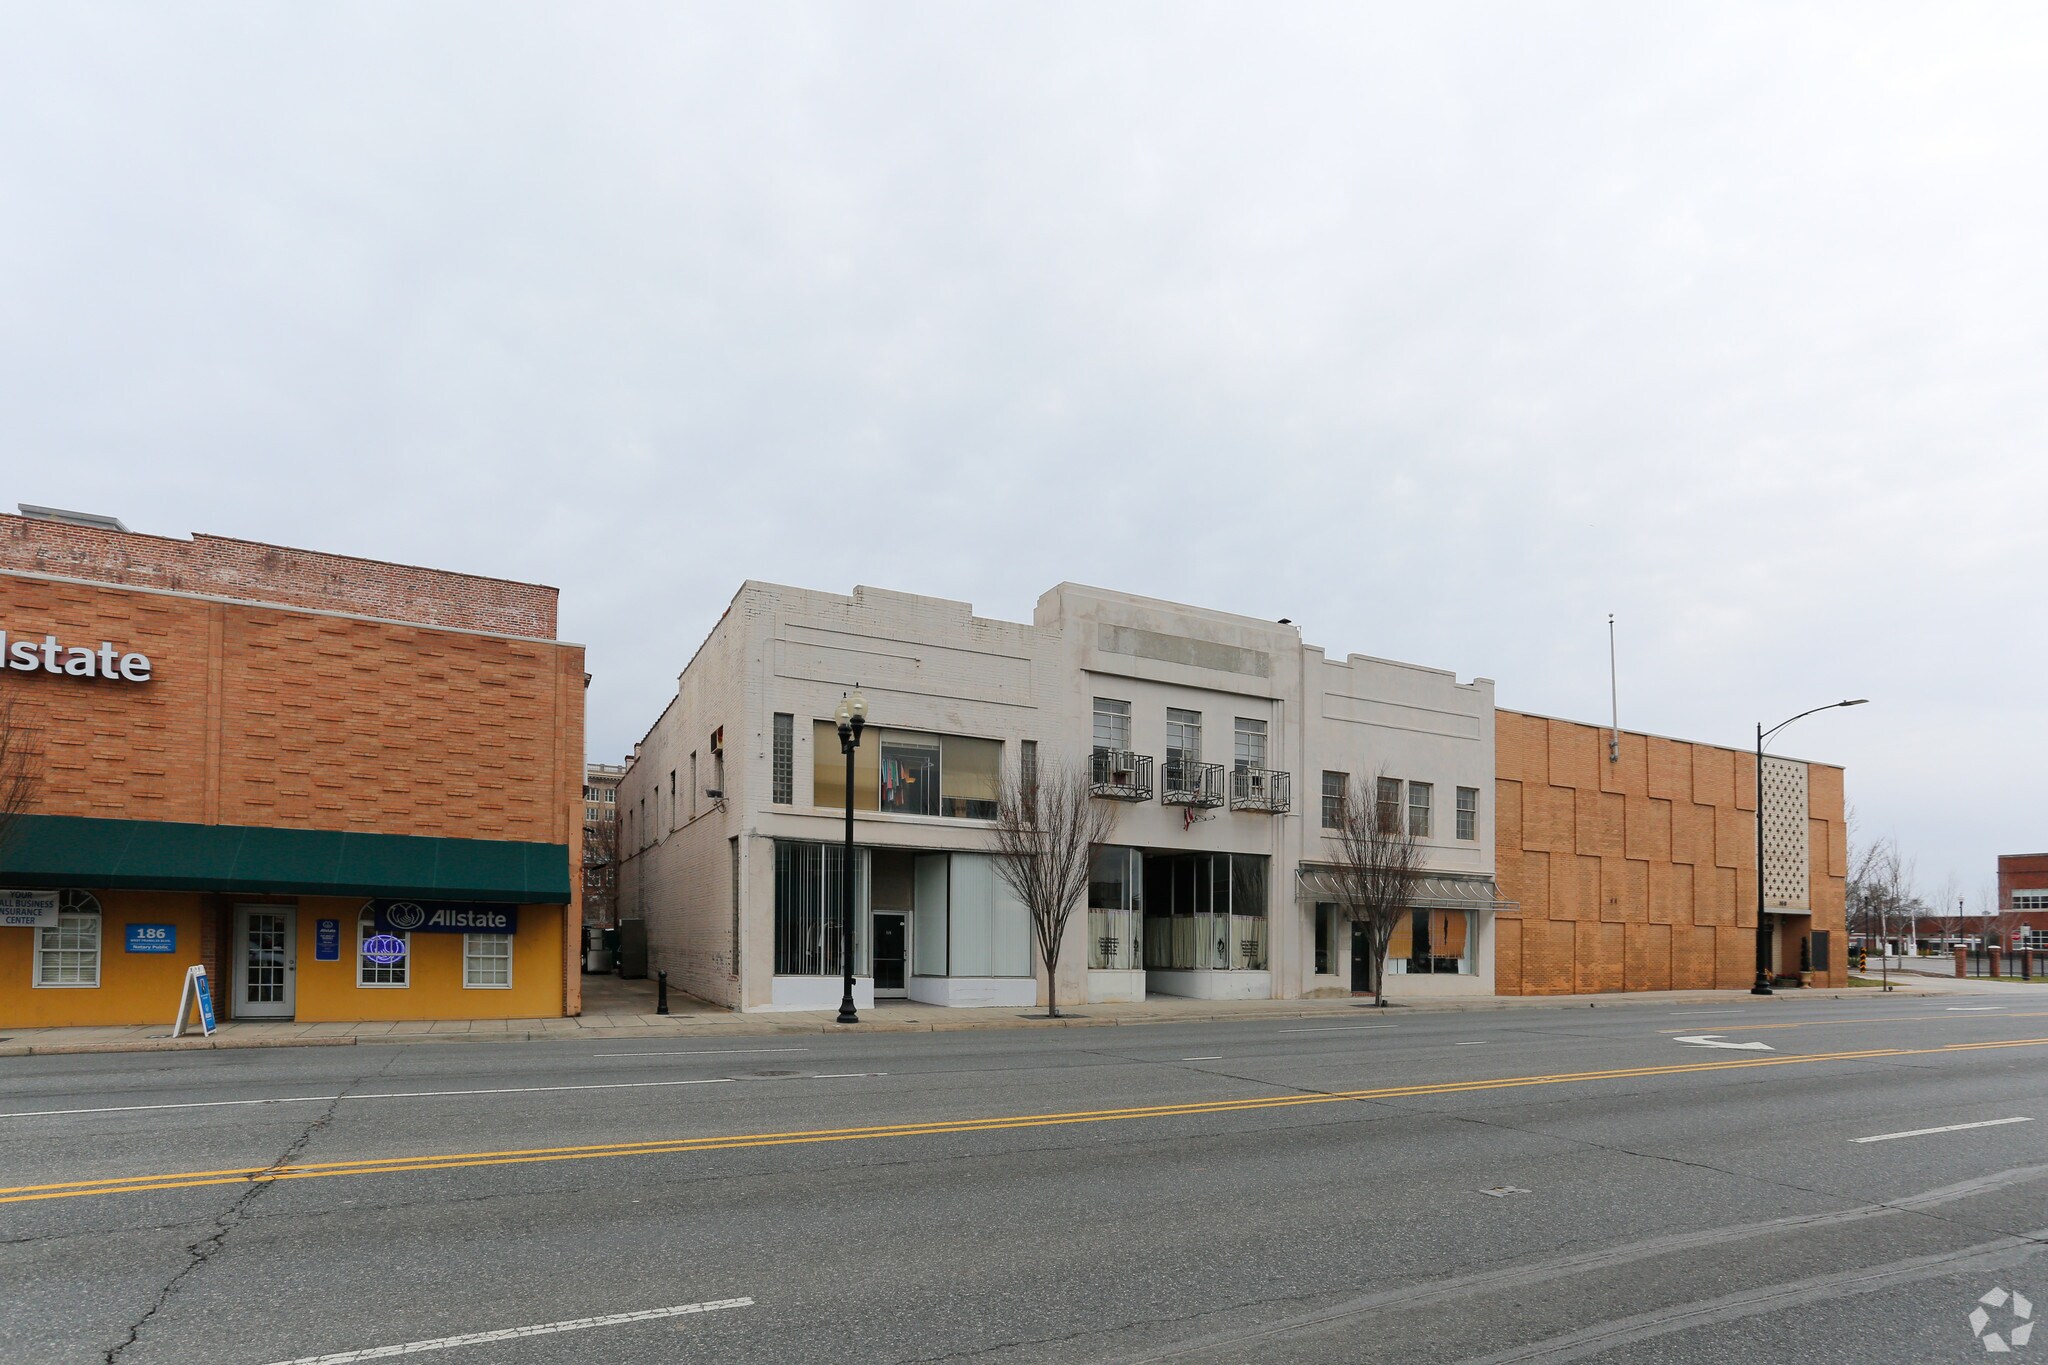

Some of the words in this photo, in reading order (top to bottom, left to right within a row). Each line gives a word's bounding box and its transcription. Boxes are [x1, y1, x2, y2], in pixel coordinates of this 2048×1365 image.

[10, 891, 33, 899] YOUR
[15, 900, 54, 909] BUSINESS
[6, 916, 36, 925] CENTER
[428, 909, 507, 928] Allstate
[137, 928, 166, 939] 186
